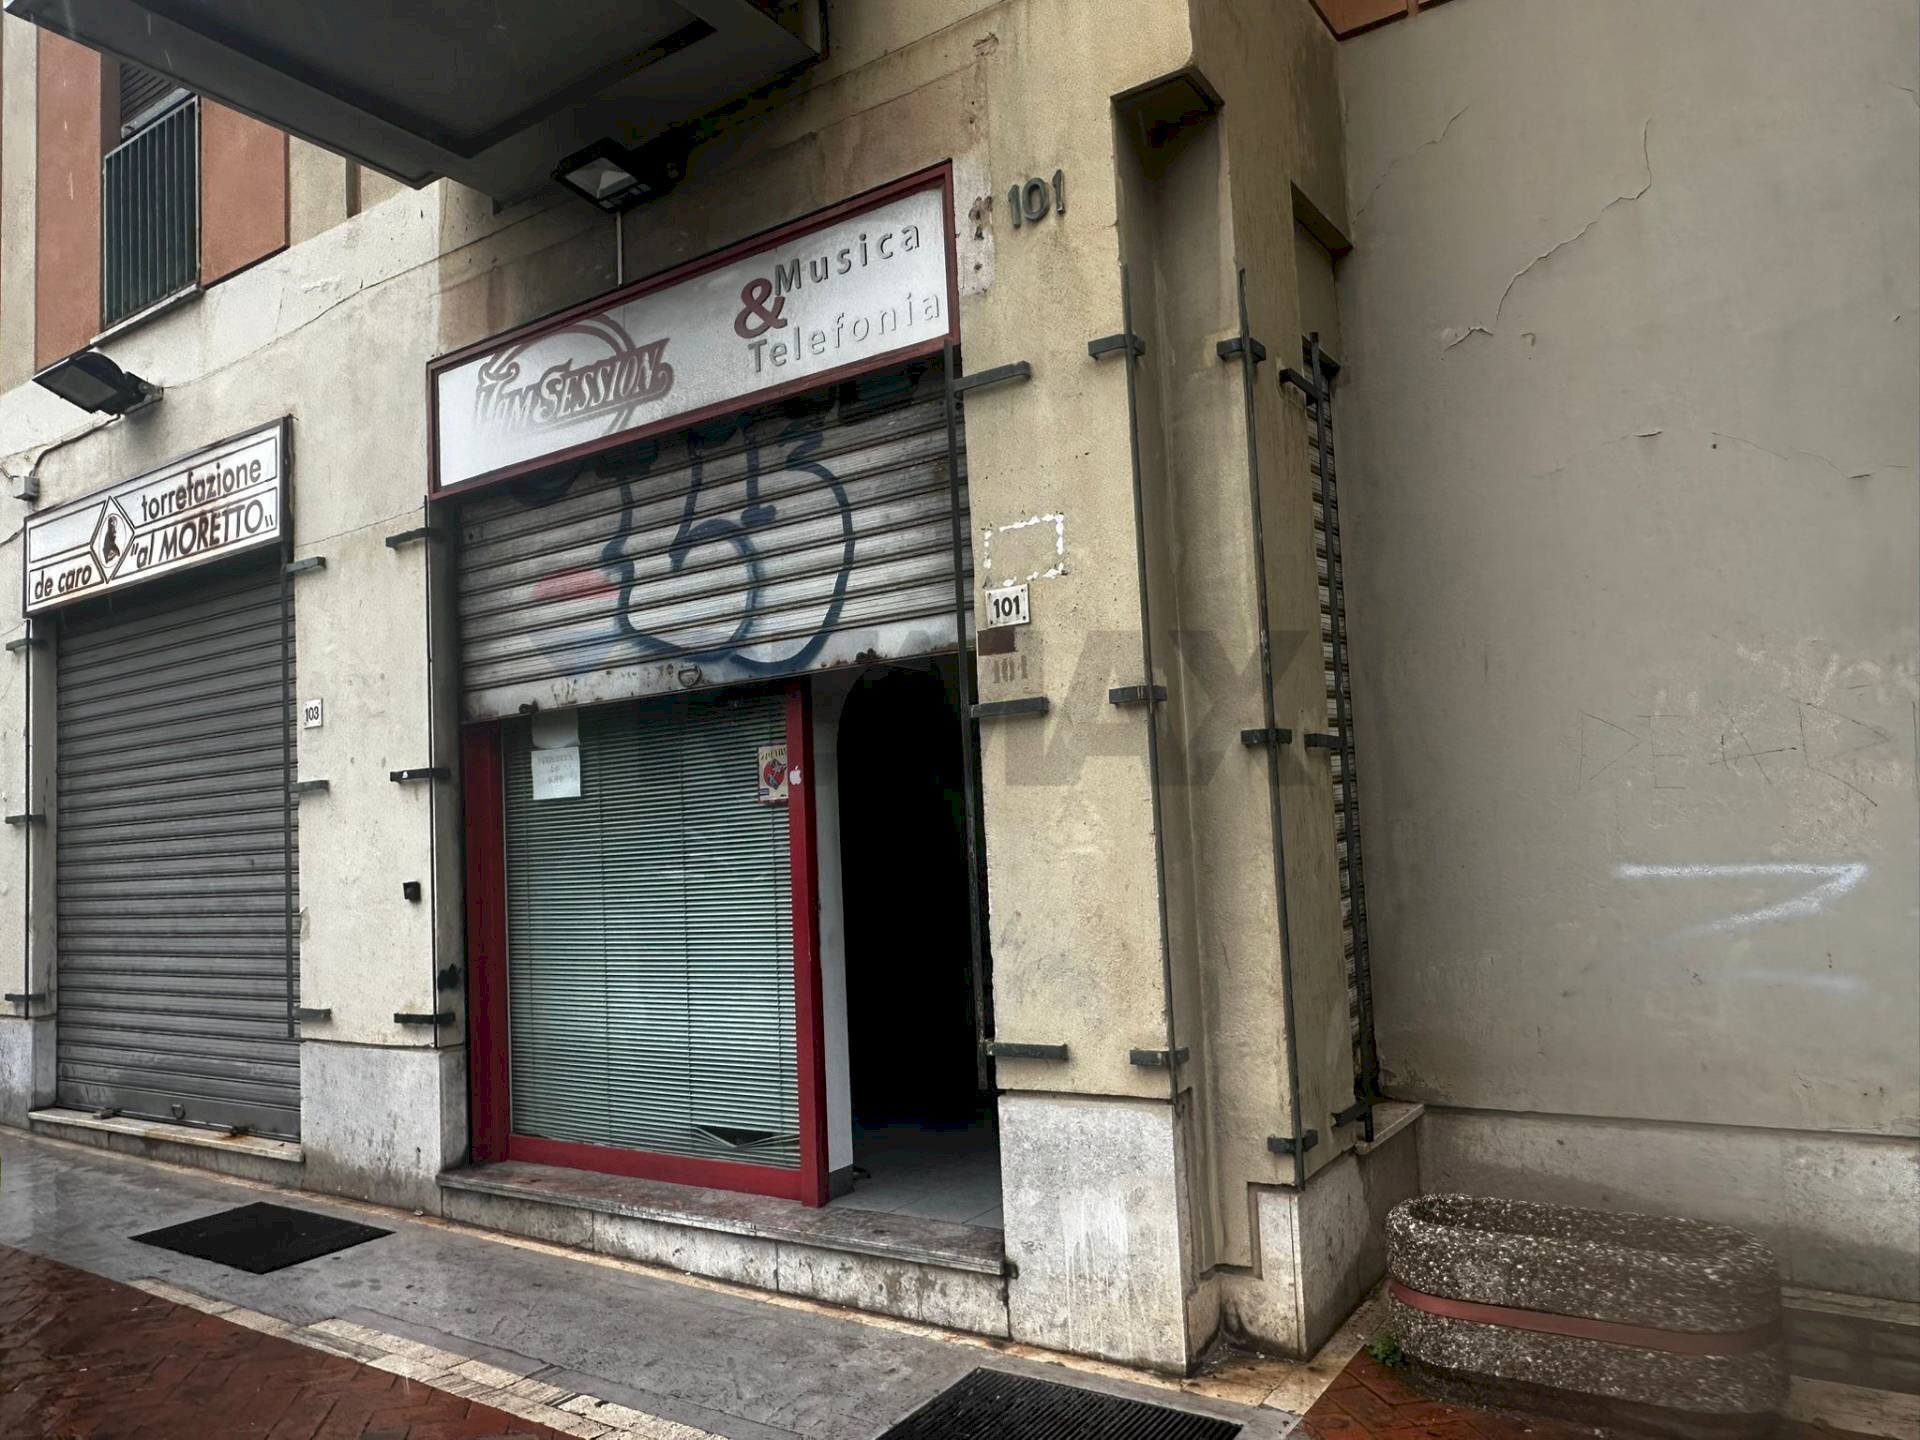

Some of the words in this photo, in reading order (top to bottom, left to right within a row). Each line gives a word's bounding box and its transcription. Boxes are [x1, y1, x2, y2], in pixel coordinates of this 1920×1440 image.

[1007, 169, 1066, 229] 101
[774, 224, 920, 297] Musica
[734, 277, 788, 339] &
[748, 292, 940, 373] Telefonia
[141, 458, 262, 522] torrefazione
[34, 567, 54, 600] de
[57, 563, 93, 595] caro
[993, 594, 1021, 619] 101
[304, 705, 321, 722] 103
